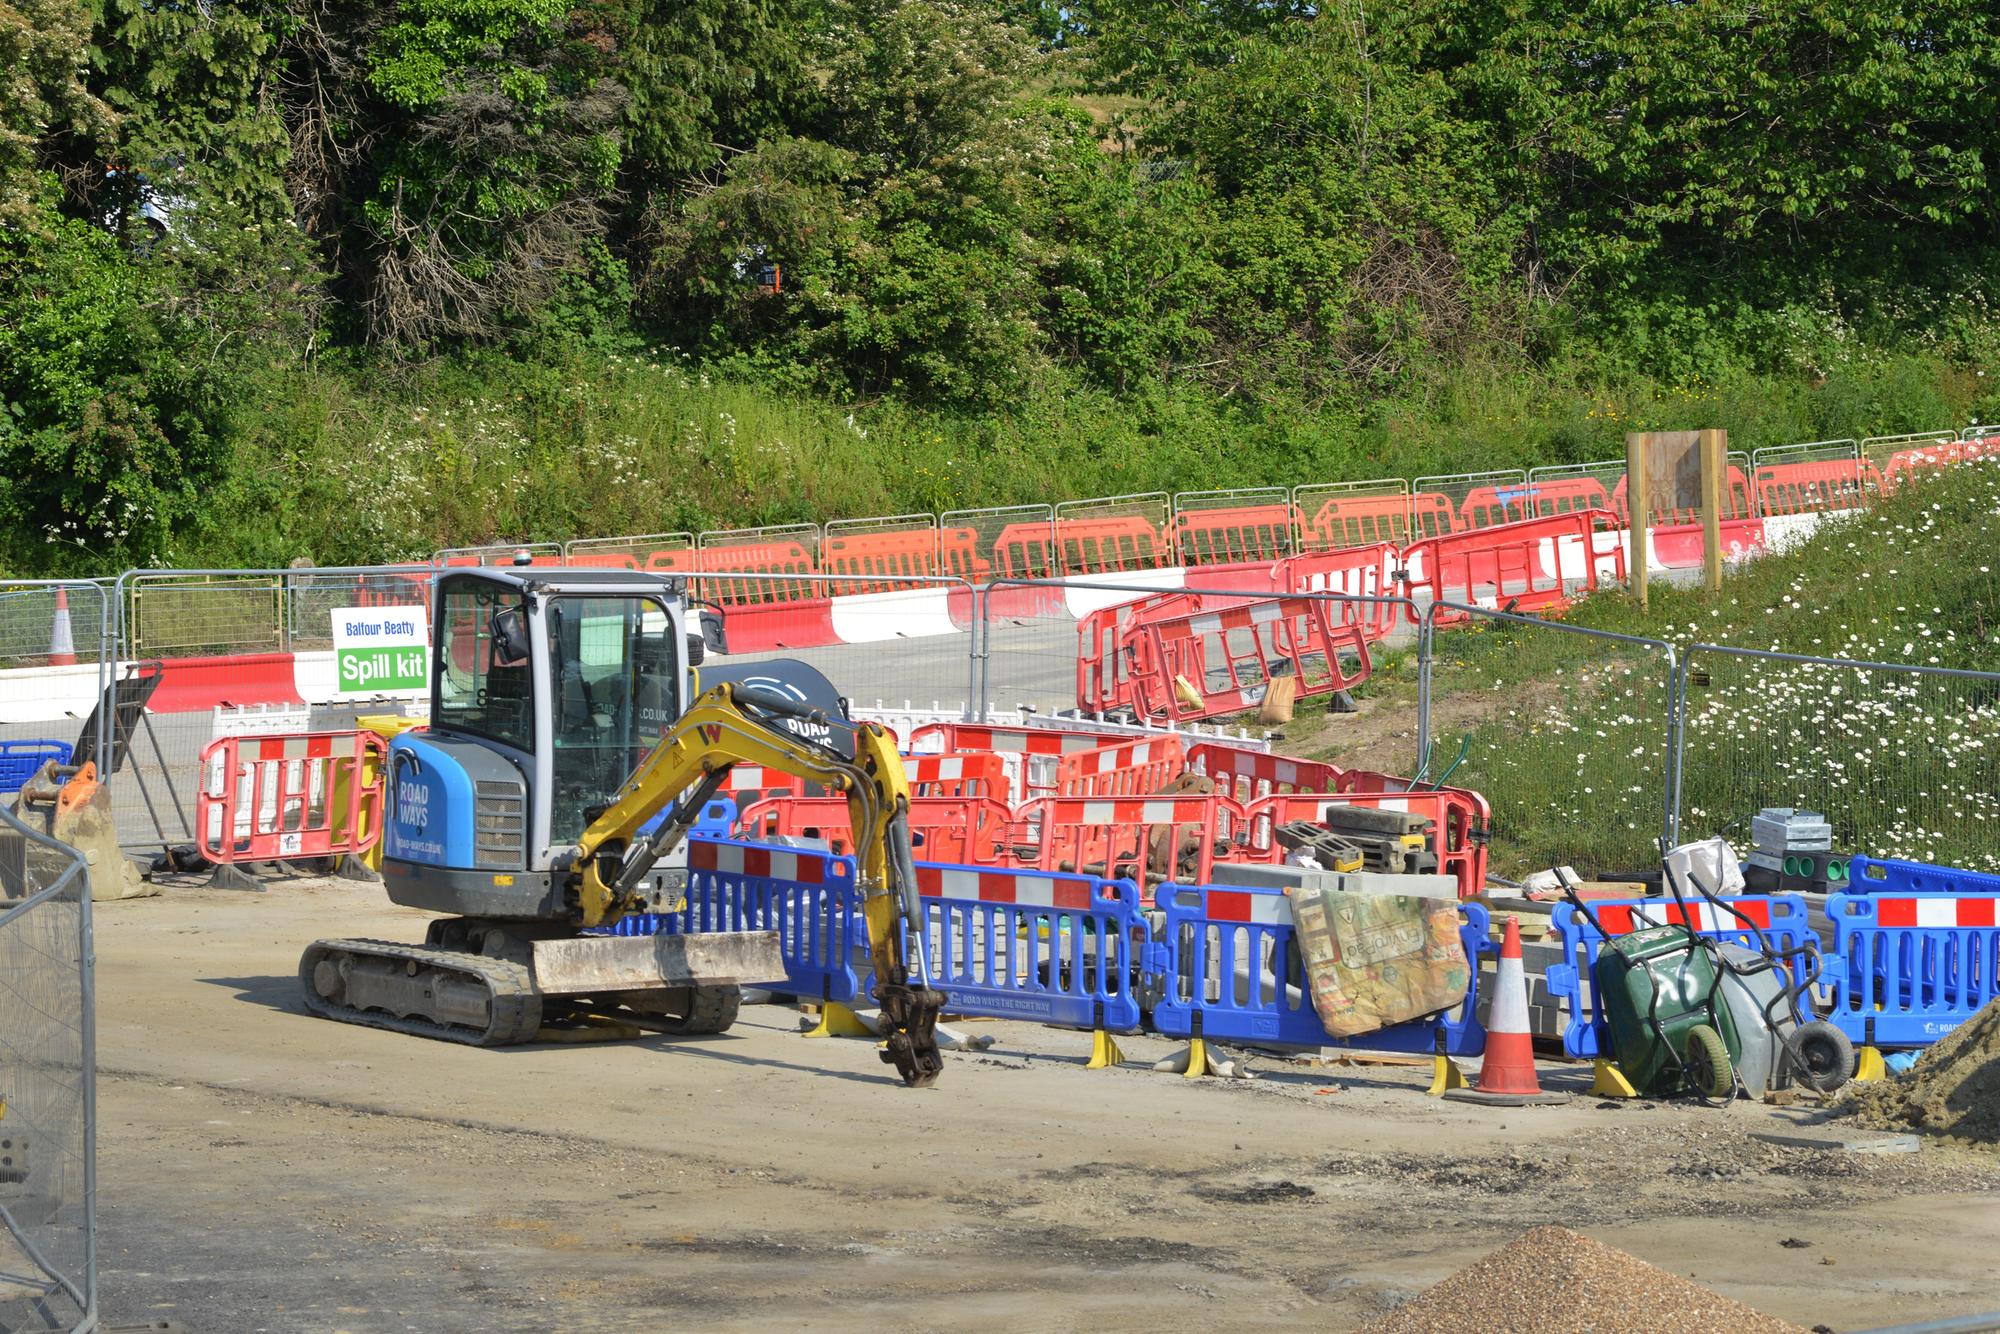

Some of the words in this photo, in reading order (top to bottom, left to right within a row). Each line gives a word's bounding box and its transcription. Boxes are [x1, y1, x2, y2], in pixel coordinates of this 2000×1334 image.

[346, 622, 381, 636] Balfour
[384, 621, 415, 636] Beatty
[342, 653, 391, 685] Spill
[397, 652, 424, 677] kit
[400, 781, 429, 804] ROAD
[400, 804, 428, 827] WAYS
